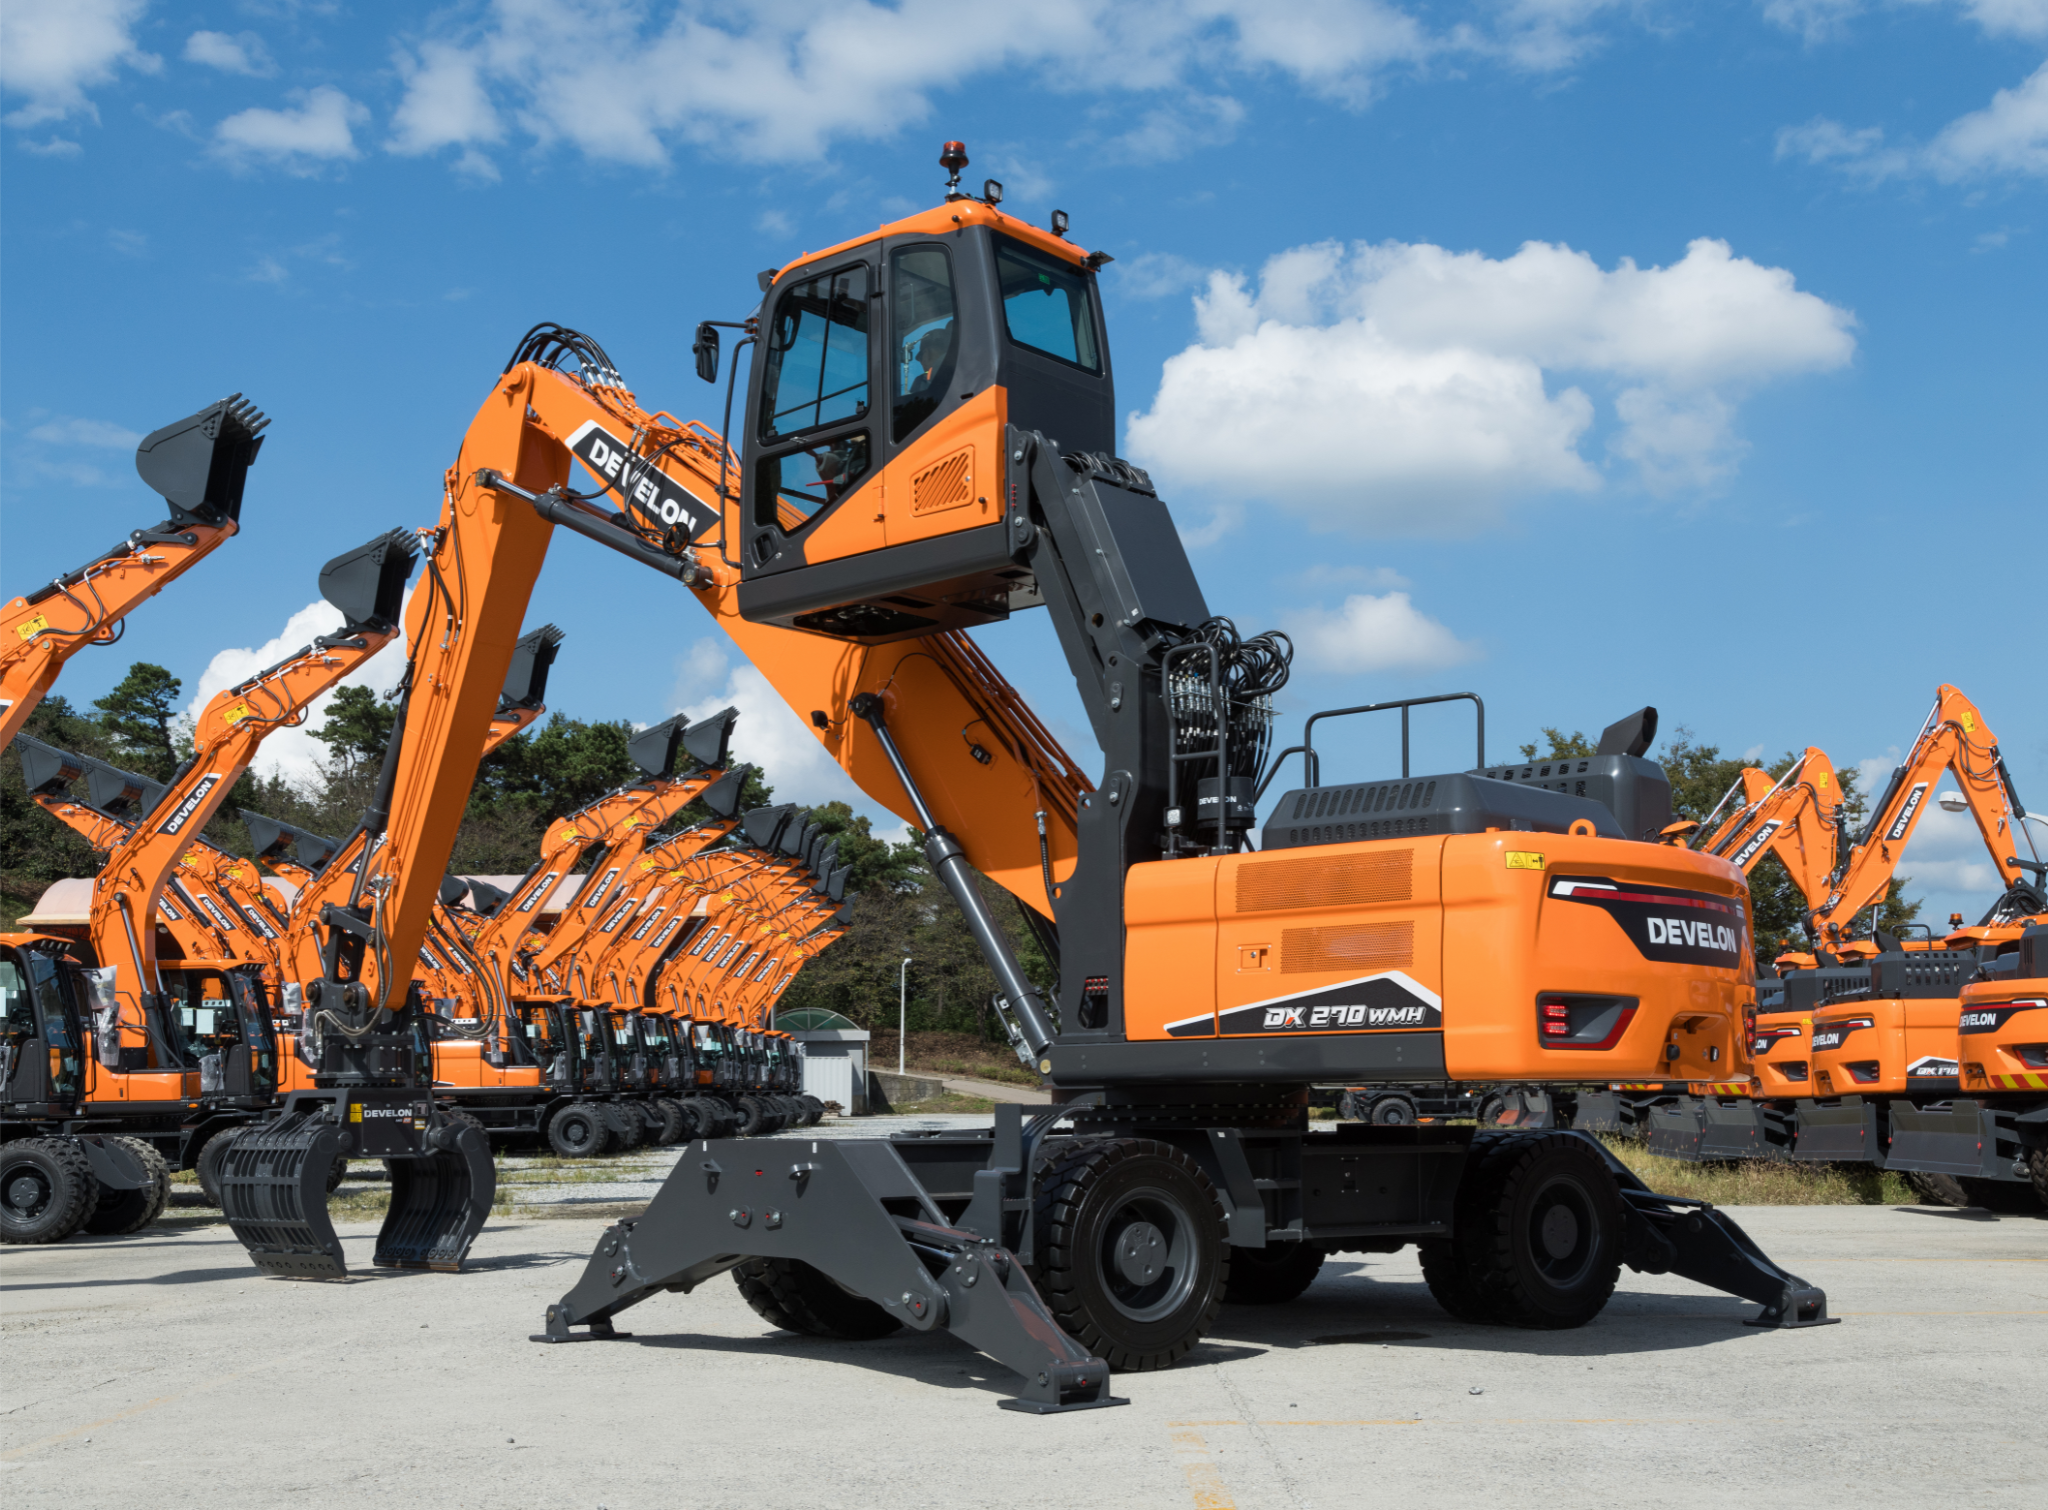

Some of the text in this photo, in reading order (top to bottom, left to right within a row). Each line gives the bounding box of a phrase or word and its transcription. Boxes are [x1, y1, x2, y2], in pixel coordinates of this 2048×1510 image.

[167, 780, 212, 833] DEVELON
[1199, 796, 1237, 805] DEVEON
[1892, 789, 1923, 838] DEVELON
[1734, 826, 1773, 867] EVELON
[522, 877, 553, 911] DEVELON
[589, 872, 615, 907] DEVELON
[203, 898, 231, 930] DEVELON
[248, 909, 275, 938] DEVELON
[605, 902, 632, 932] DEVELON
[635, 910, 661, 939] DEVELON
[653, 919, 678, 947] DEVELON
[692, 929, 716, 955] DEVELON
[1646, 917, 1738, 953] DEVELON
[705, 937, 728, 962] DEVELON
[719, 943, 740, 968] DEVELON
[1263, 1004, 1427, 1029] DX 270 WMH
[363, 1108, 413, 1118] DEVELON
